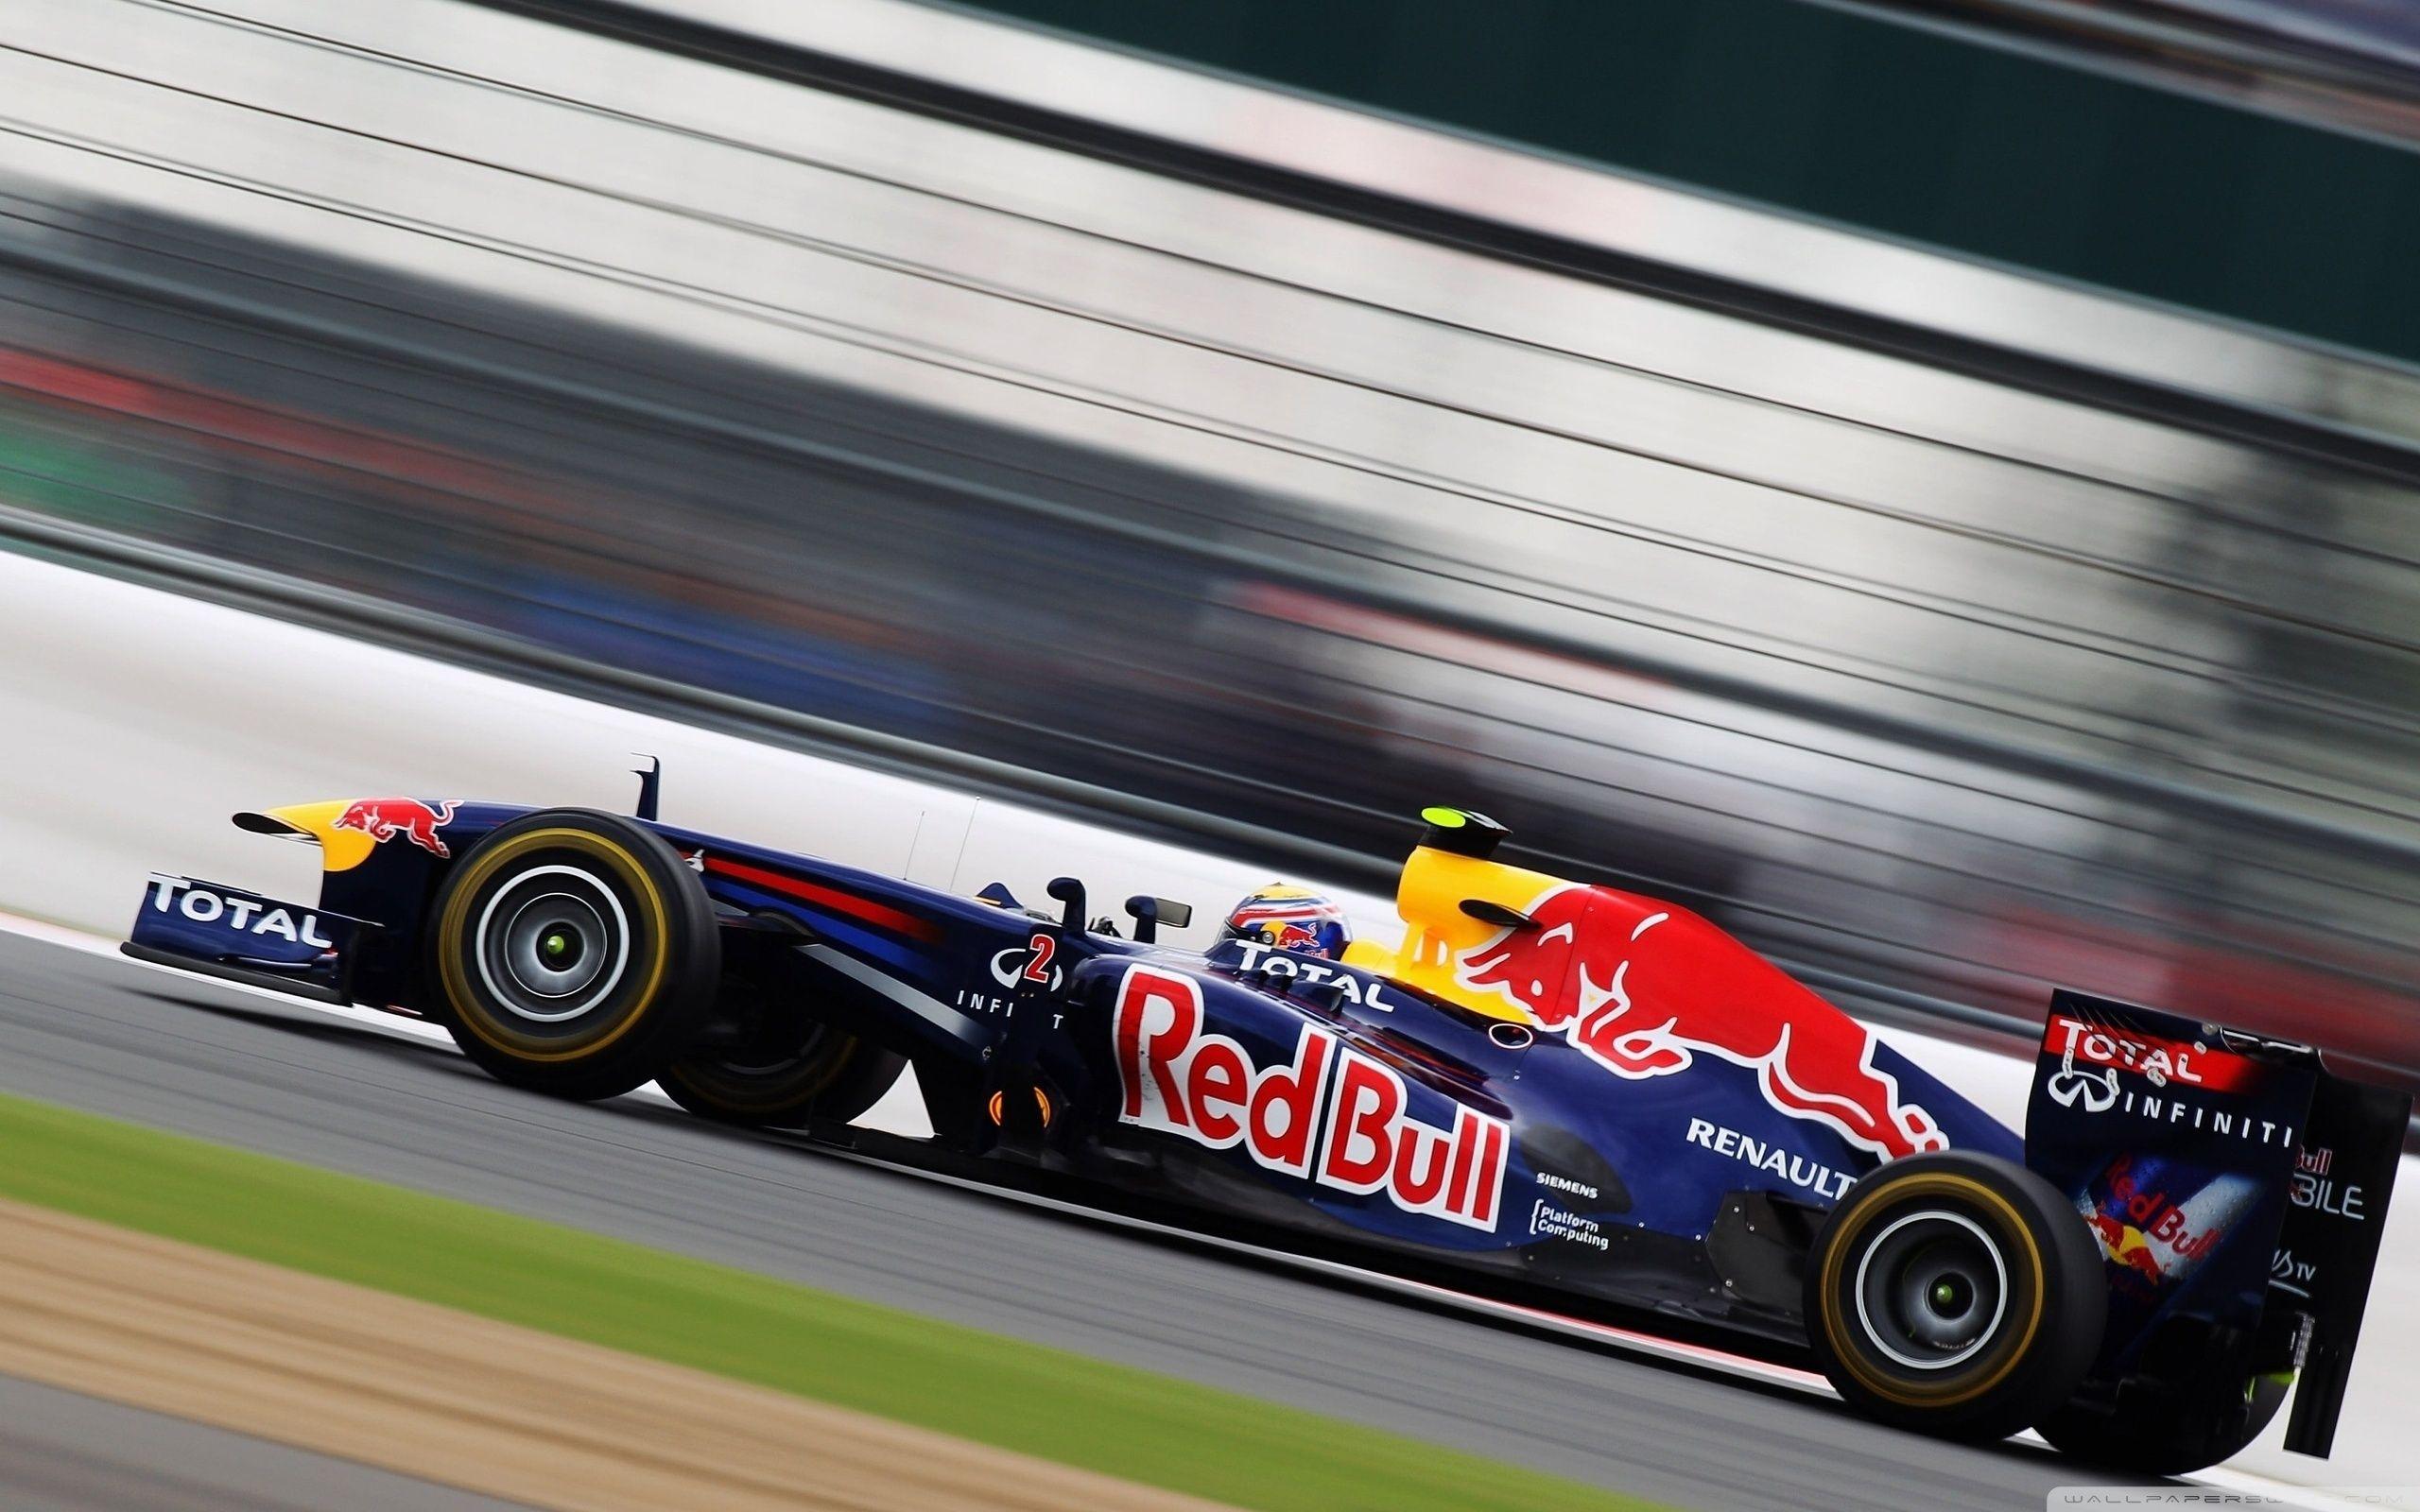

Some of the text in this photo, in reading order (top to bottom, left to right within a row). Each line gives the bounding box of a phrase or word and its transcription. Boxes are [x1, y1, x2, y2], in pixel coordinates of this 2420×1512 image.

[149, 874, 333, 948] TOTAL
[1023, 933, 1056, 984] 2
[1236, 938, 1394, 1013] TOTAL
[2058, 1018, 2203, 1084] TOTAL
[1119, 970, 1503, 1223] Red Bull
[2125, 1091, 2292, 1148] INFINITI
[1536, 1172, 1599, 1199] SIEMENS
[1685, 1117, 1858, 1201] RENAULT
[1537, 1218, 1609, 1251] Computing
[1540, 1206, 1599, 1232] Platform
